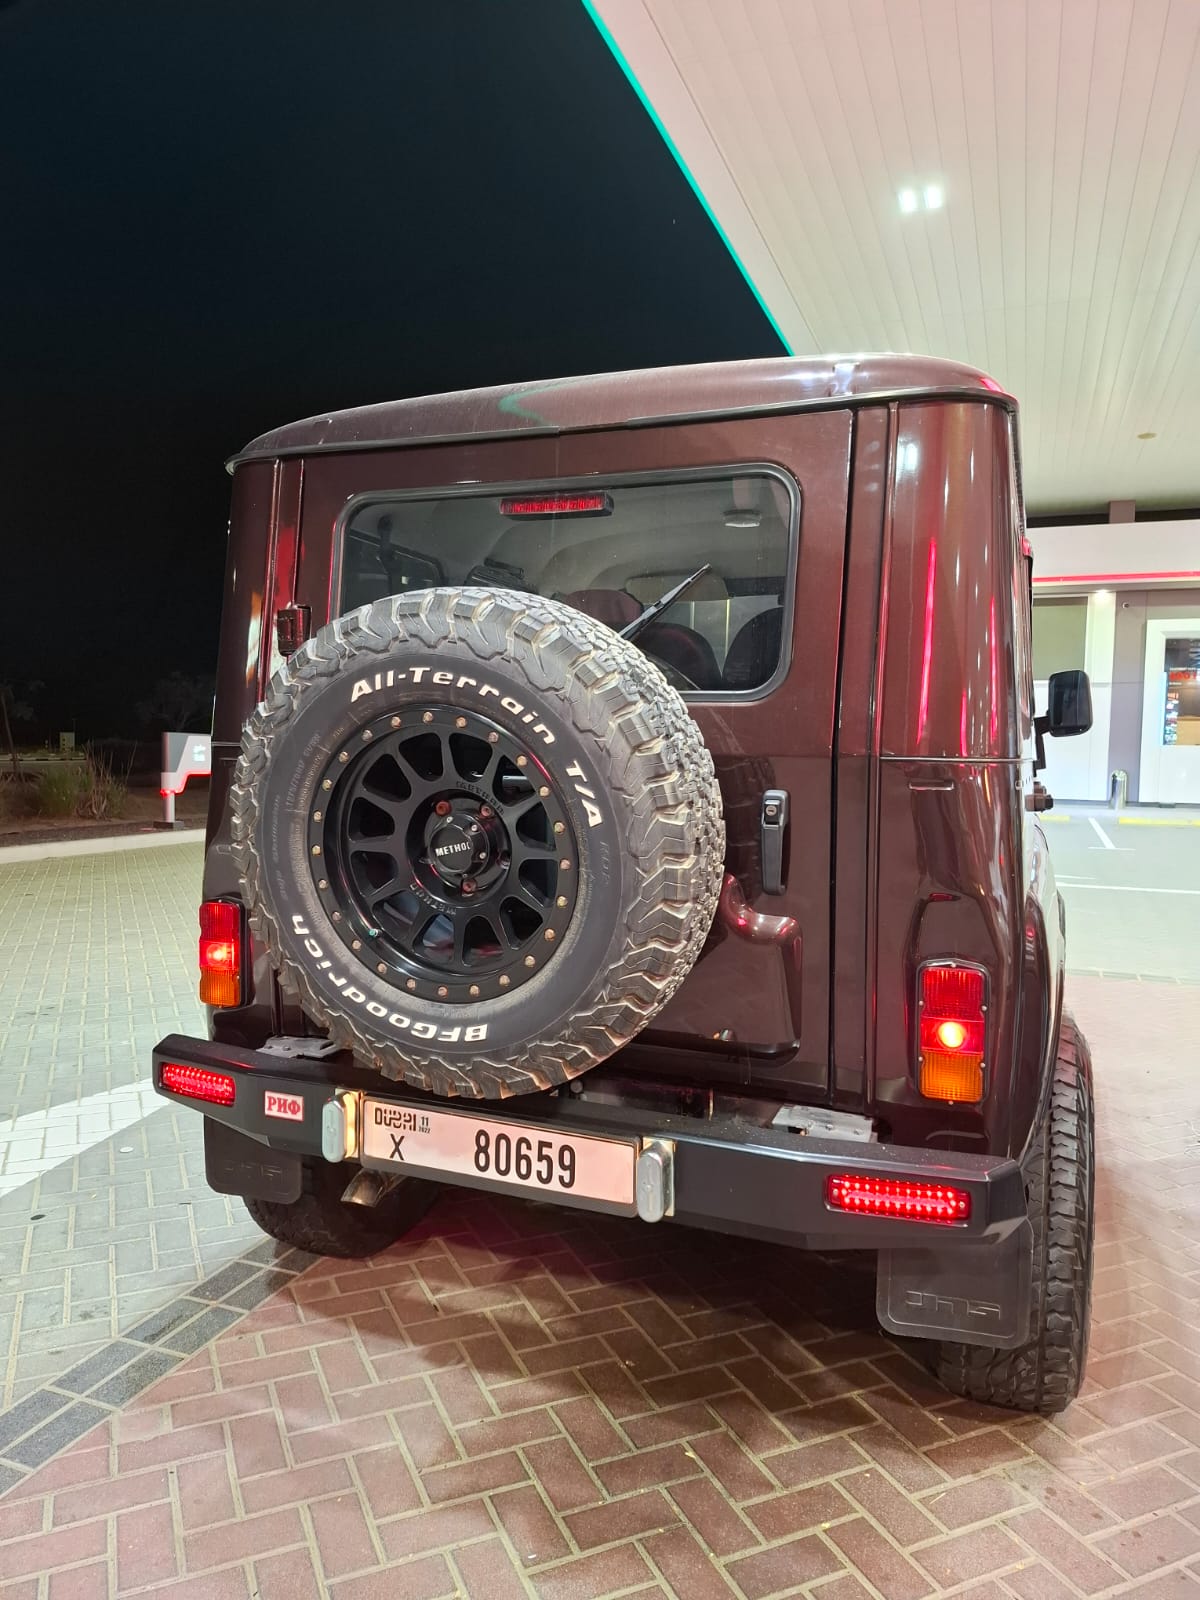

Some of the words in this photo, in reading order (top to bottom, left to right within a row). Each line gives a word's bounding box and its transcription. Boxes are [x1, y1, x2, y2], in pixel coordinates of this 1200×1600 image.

[351, 666, 556, 745] All-Terrain
[566, 760, 603, 827] T/A
[291, 915, 488, 1043] BFGoodrich
[266, 1095, 301, 1117] РИФ
[420, 1116, 429, 1127] 11
[389, 1132, 406, 1161] X
[473, 1128, 577, 1189] 80659
